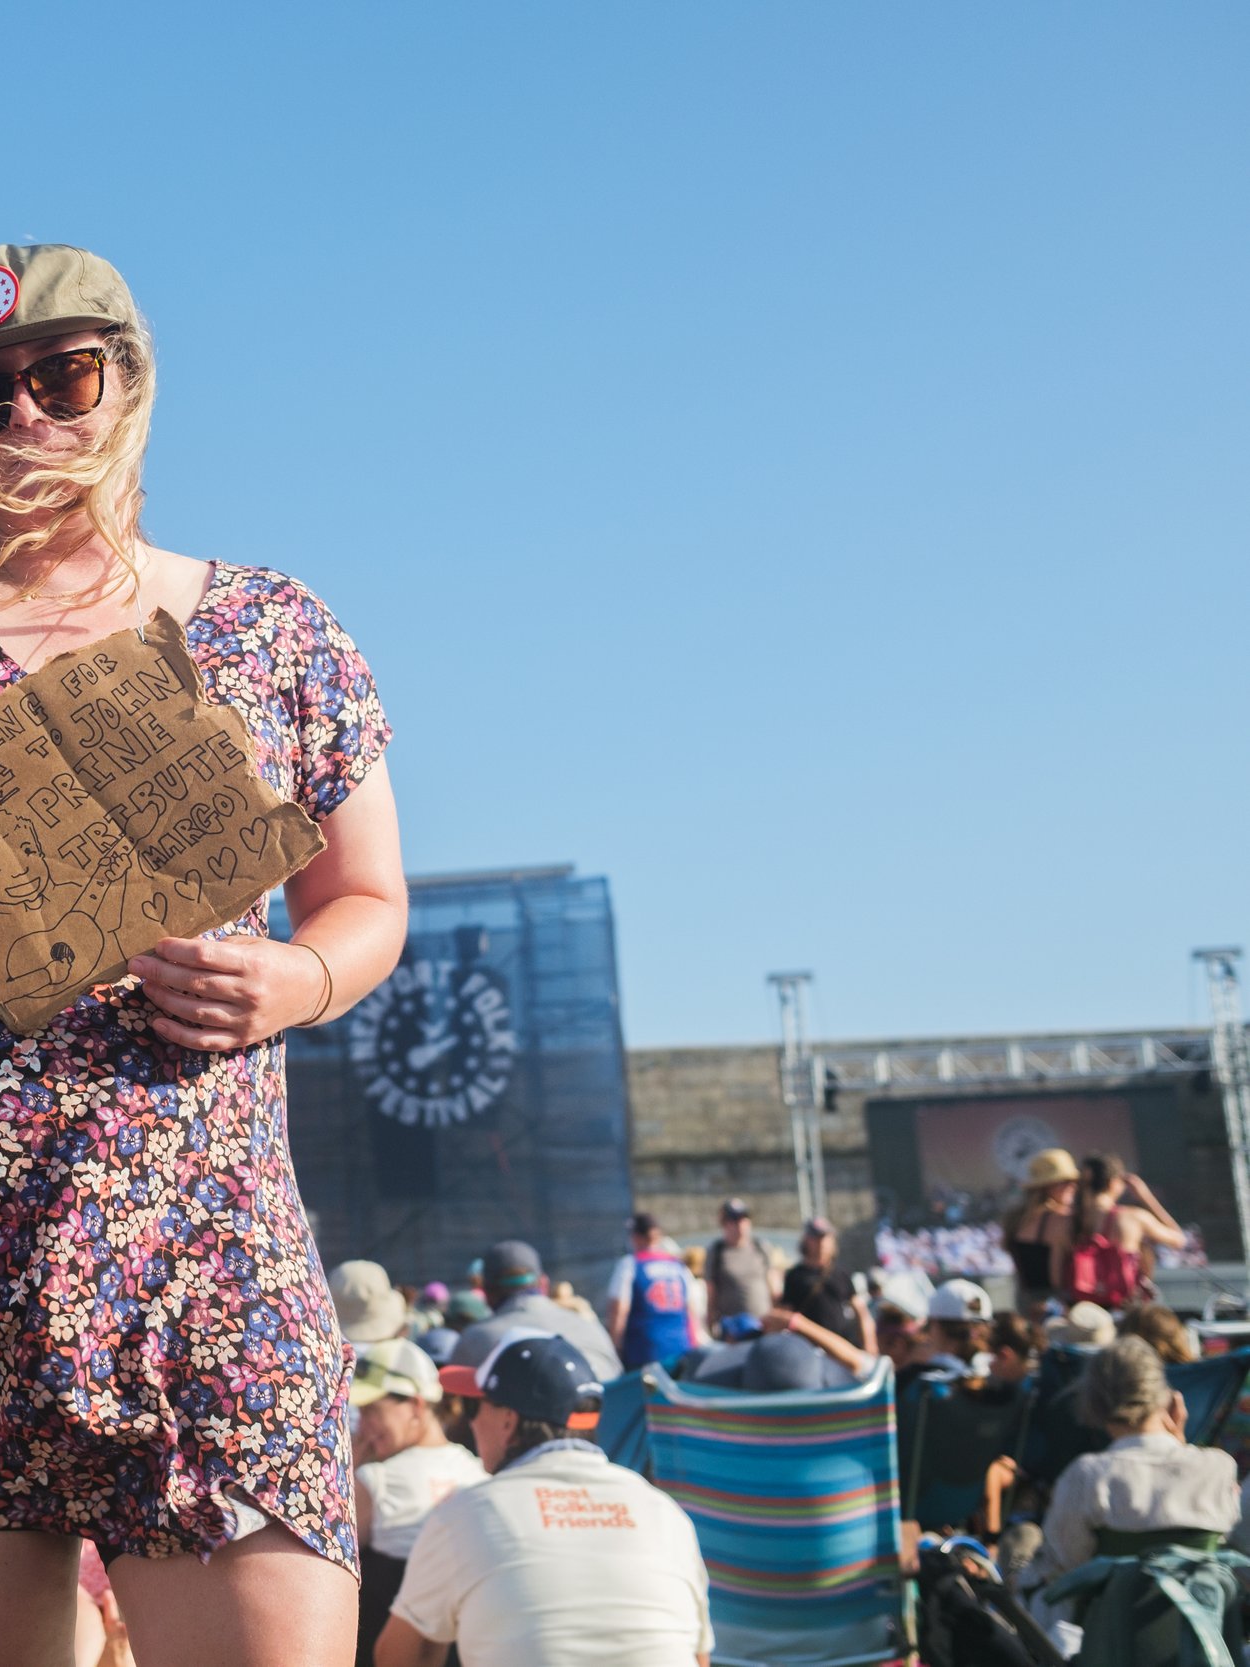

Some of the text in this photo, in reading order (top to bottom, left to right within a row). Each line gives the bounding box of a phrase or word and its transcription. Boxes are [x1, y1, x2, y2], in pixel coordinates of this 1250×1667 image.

[25, 728, 63, 759] TO
[70, 656, 187, 749] JOHN
[60, 653, 119, 699] FOR
[25, 712, 176, 828] PRINE
[57, 730, 247, 870] TRIBUTE
[136, 784, 249, 879] (MARGO)
[459, 972, 518, 1052] FOLK
[543, 1513, 636, 1528] Friends
